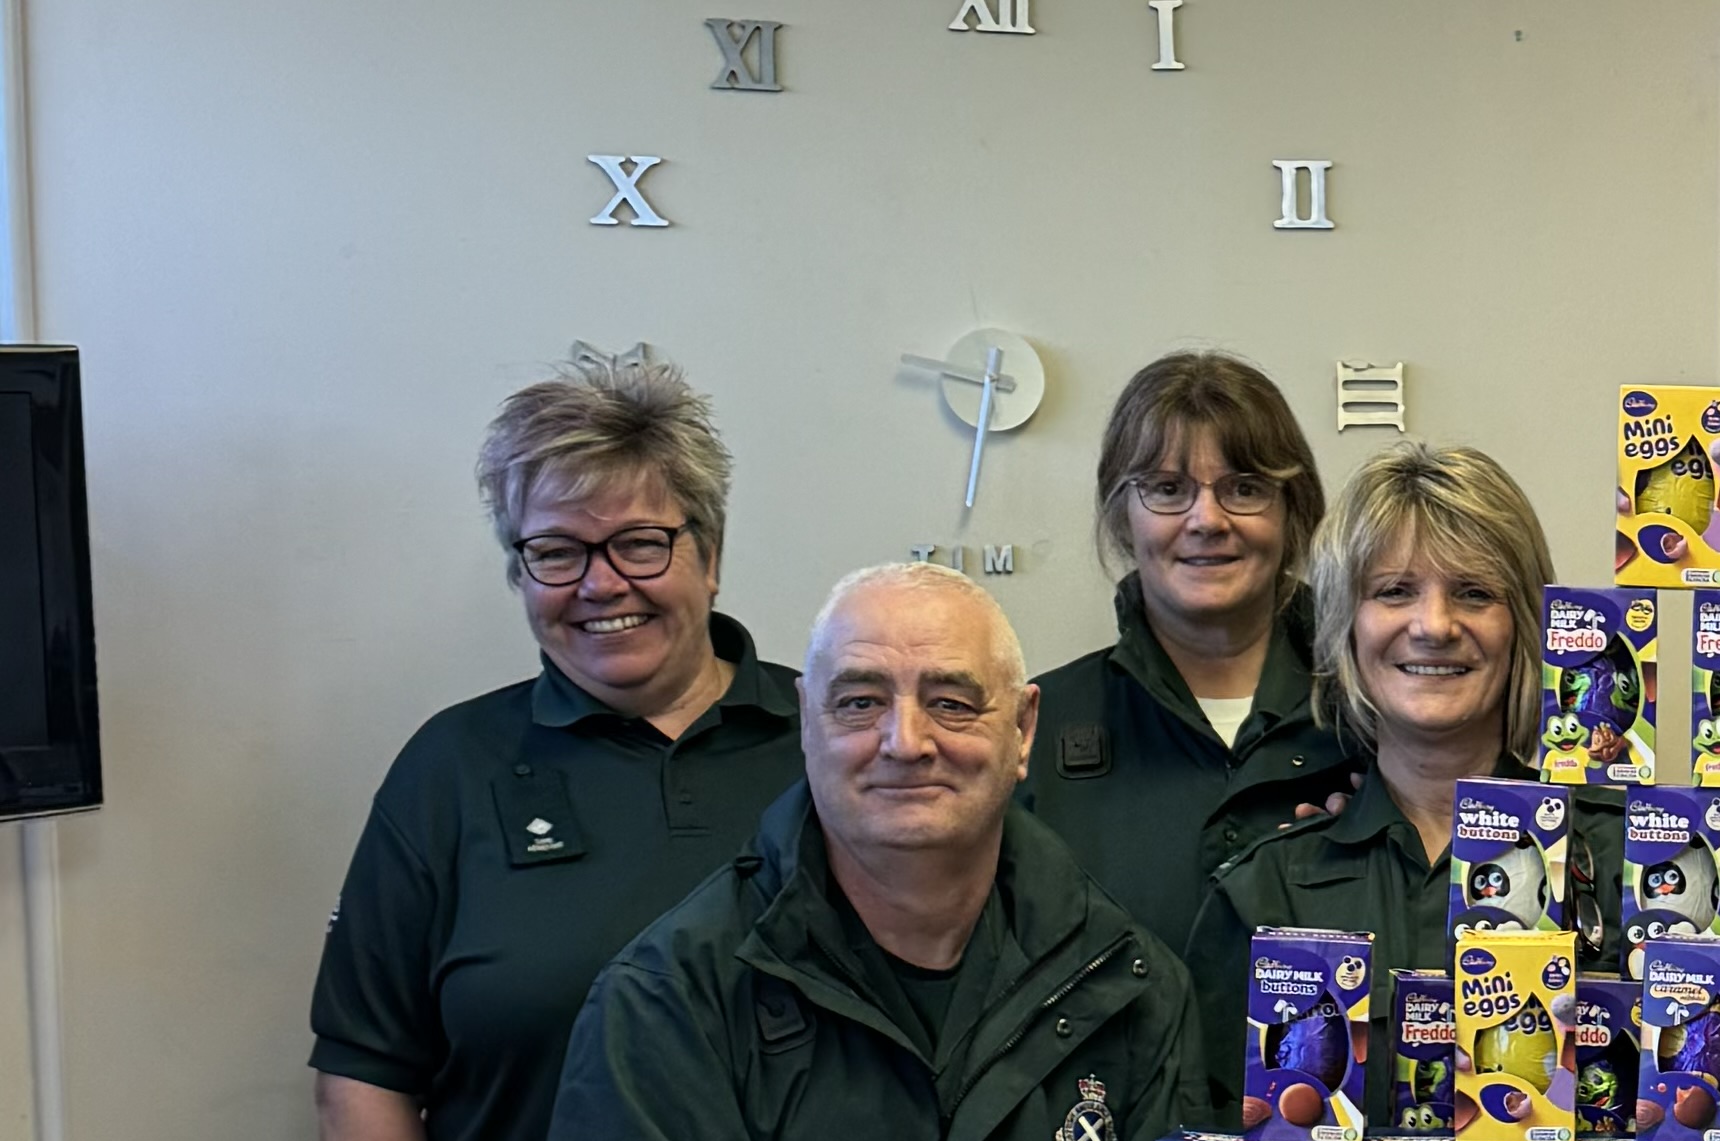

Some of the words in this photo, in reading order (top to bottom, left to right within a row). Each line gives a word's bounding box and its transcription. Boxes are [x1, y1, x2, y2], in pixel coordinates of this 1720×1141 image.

[705, 18, 784, 91] XI
[587, 155, 669, 228] X
[1272, 159, 1335, 230] II
[1623, 414, 1673, 441] Mini
[1624, 436, 1680, 459] eggs
[1550, 609, 1585, 621] DAIRY
[1550, 619, 1578, 629] MILK
[1550, 631, 1604, 650] Freddo
[1459, 811, 1520, 828] white
[1629, 813, 1690, 830] white
[1457, 826, 1520, 842] buttons
[1628, 828, 1690, 843] buttons
[1255, 968, 1292, 981] DAIRY
[1293, 970, 1323, 983] MILK
[1649, 971, 1687, 983] DAIRY
[1687, 973, 1715, 986] MILK
[1260, 981, 1318, 997] buttons
[1461, 971, 1514, 1000] Mini
[1405, 1002, 1439, 1013] DAIRY
[1463, 994, 1521, 1017] eggs
